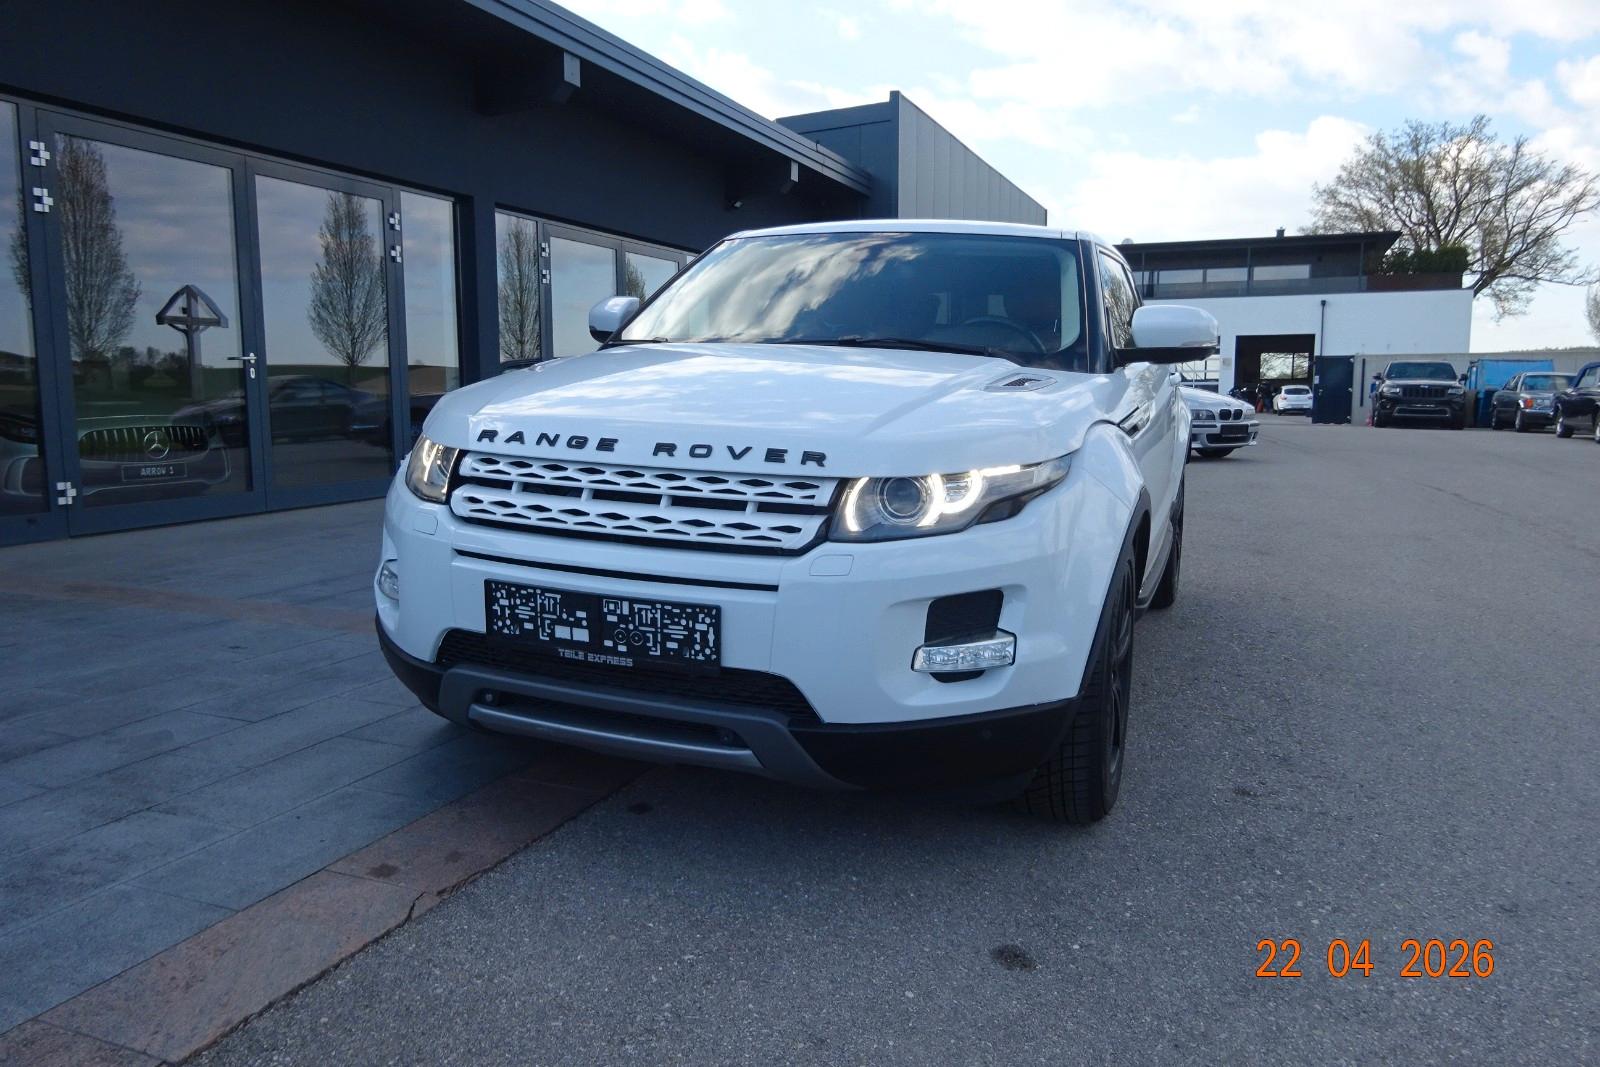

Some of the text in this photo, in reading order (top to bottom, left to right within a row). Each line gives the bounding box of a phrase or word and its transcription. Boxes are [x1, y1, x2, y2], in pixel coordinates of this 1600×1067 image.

[476, 429, 827, 467] RANGE ROVER
[587, 652, 633, 667] EXPRESS
